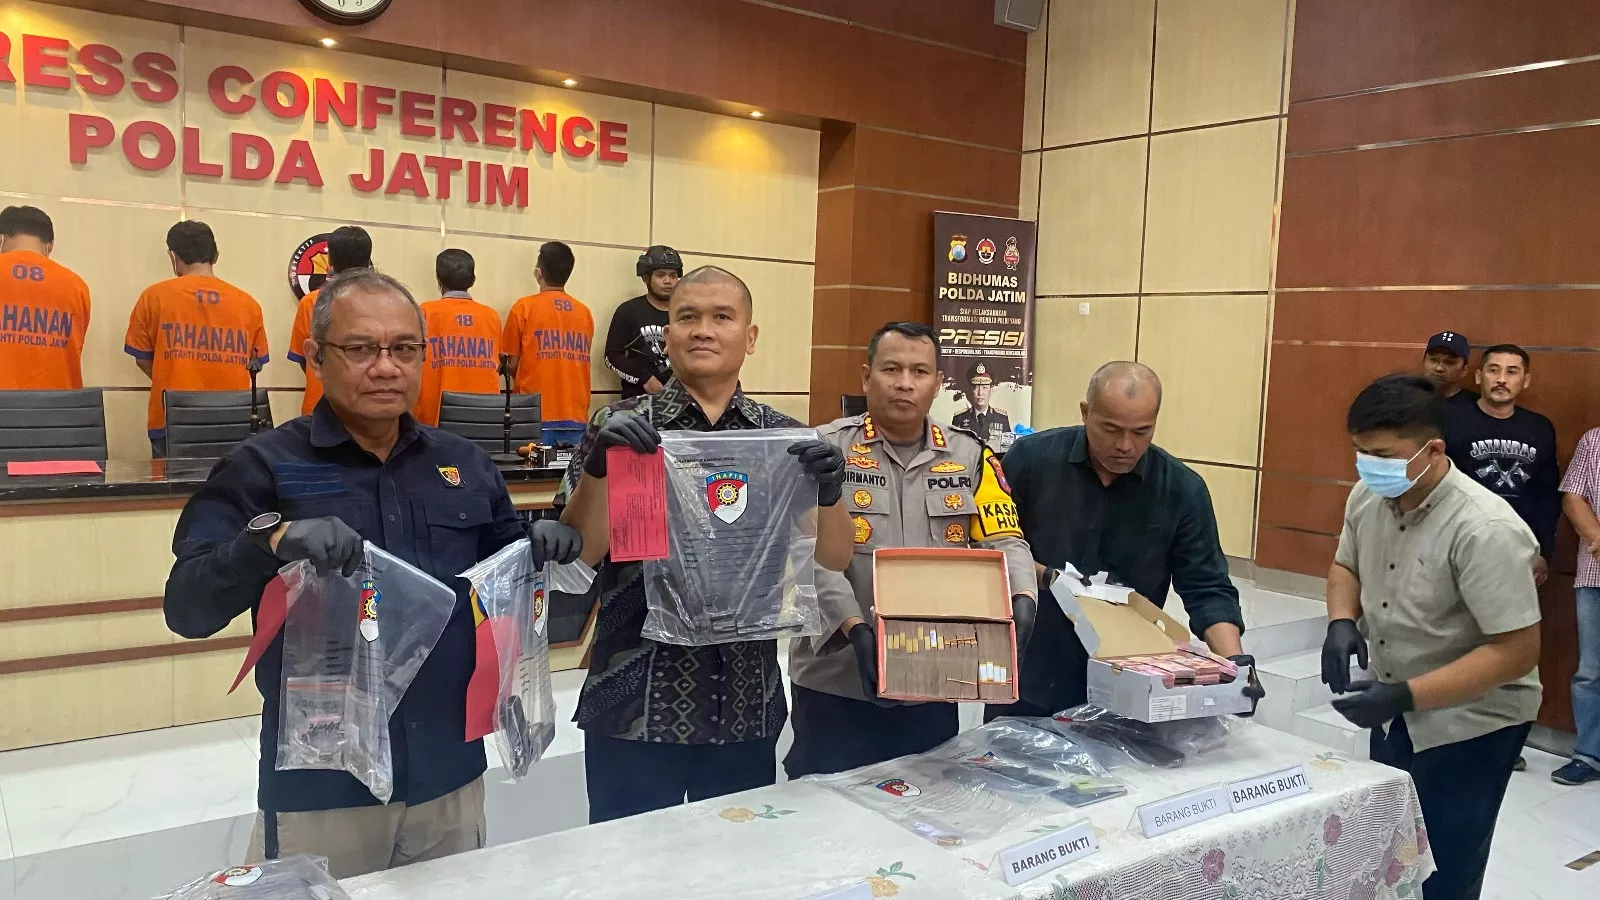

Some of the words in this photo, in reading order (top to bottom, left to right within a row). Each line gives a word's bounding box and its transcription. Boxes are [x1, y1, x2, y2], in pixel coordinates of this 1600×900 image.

[207, 65, 628, 162] CONFERENCE
[69, 113, 324, 187] POLDA
[348, 149, 529, 208] JATIM
[12, 264, 44, 281] 08
[948, 272, 1018, 288] BIDHUMAS
[195, 289, 220, 304] 10
[939, 287, 984, 301] POLDA
[988, 290, 1026, 303] JATIM
[554, 299, 572, 312] 58
[0, 304, 73, 338] HANAN
[456, 314, 473, 327] 18
[18, 335, 47, 346] POLDA
[162, 323, 248, 354] TAHANAN
[938, 328, 1025, 346] PRESISI
[197, 352, 222, 362] POLDA
[457, 359, 476, 368] POLDA
[1470, 439, 1537, 462] JATANRAS
[928, 477, 971, 489] POLRI
[997, 517, 1020, 529] HU
[1232, 782, 1277, 804] BARANG
[1277, 774, 1306, 792] BUKTI
[1155, 806, 1192, 828] BARANG
[1193, 798, 1217, 815] BUKTI
[1012, 849, 1057, 874] BARANG
[1058, 837, 1090, 857] BUKTI
